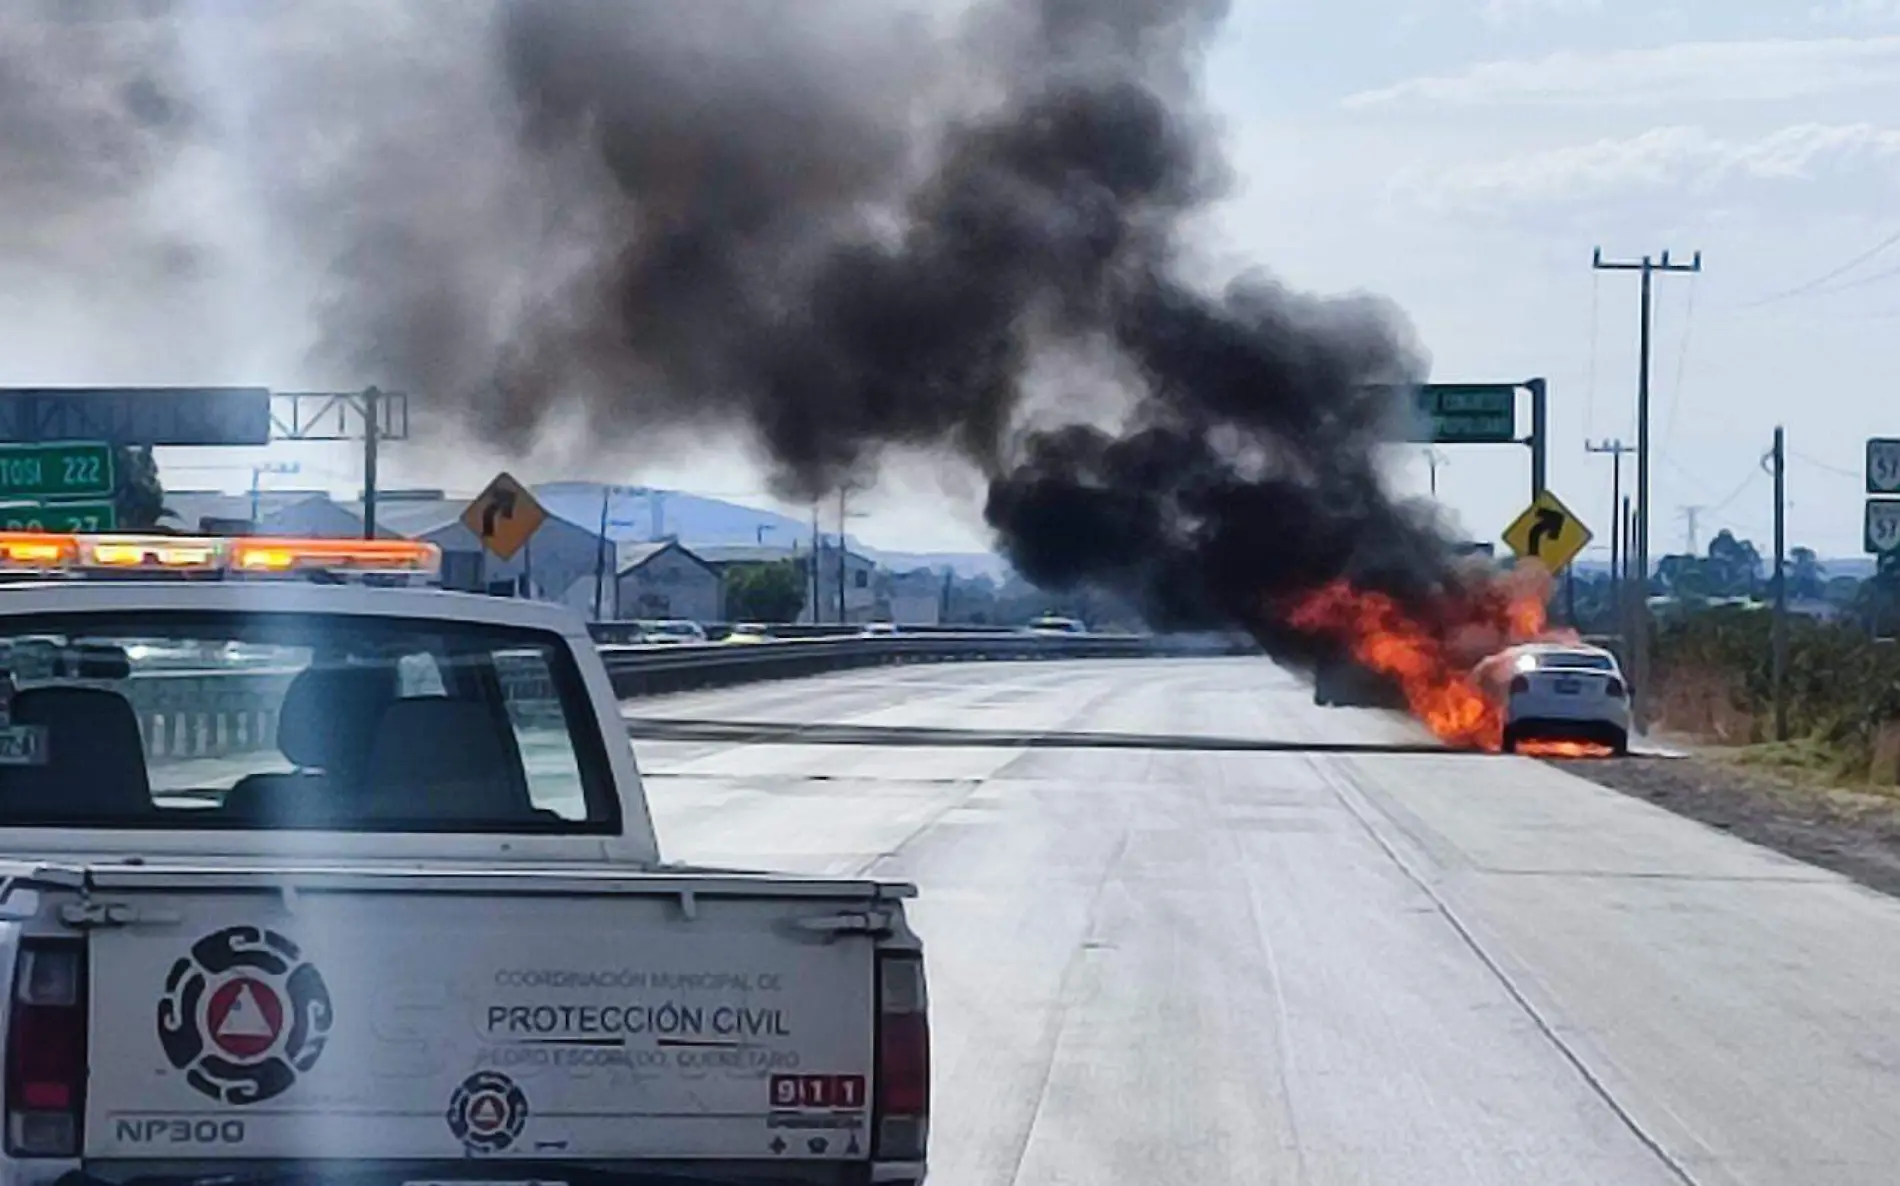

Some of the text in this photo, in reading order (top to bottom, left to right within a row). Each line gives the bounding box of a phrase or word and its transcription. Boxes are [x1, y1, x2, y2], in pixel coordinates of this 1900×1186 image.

[63, 456, 99, 483] 222
[758, 973, 782, 991] DE
[488, 1000, 790, 1036] PROTECCIÓN CIVIL
[777, 1079, 856, 1104] 911
[115, 1119, 245, 1143] NP300
